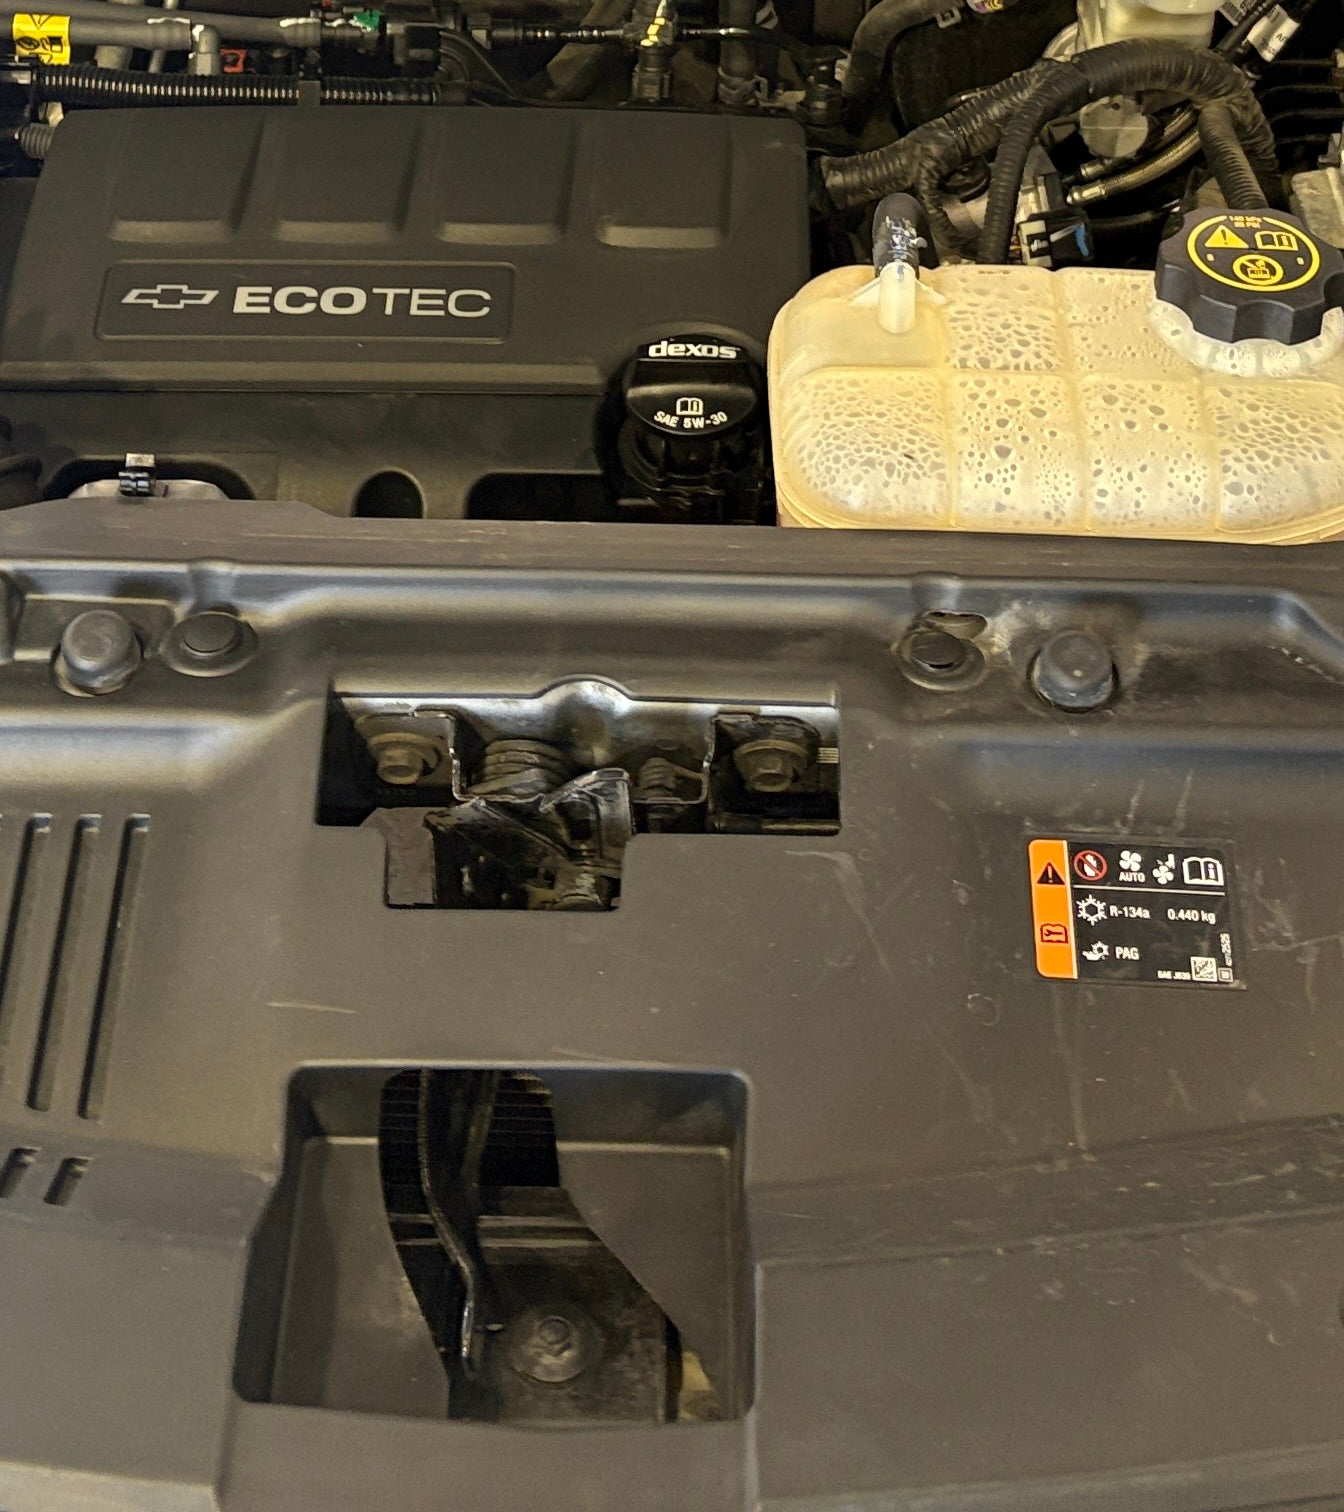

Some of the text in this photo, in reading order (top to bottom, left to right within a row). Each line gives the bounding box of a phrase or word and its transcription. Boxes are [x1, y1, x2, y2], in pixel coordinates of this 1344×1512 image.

[233, 286, 492, 318] ECOTEC
[648, 340, 739, 359] dexos
[653, 410, 728, 429] SAE 5W-30
[1118, 871, 1146, 883] AUTO
[1109, 905, 1217, 925] R-134a 0.440 kg
[1115, 946, 1140, 961] PAG
